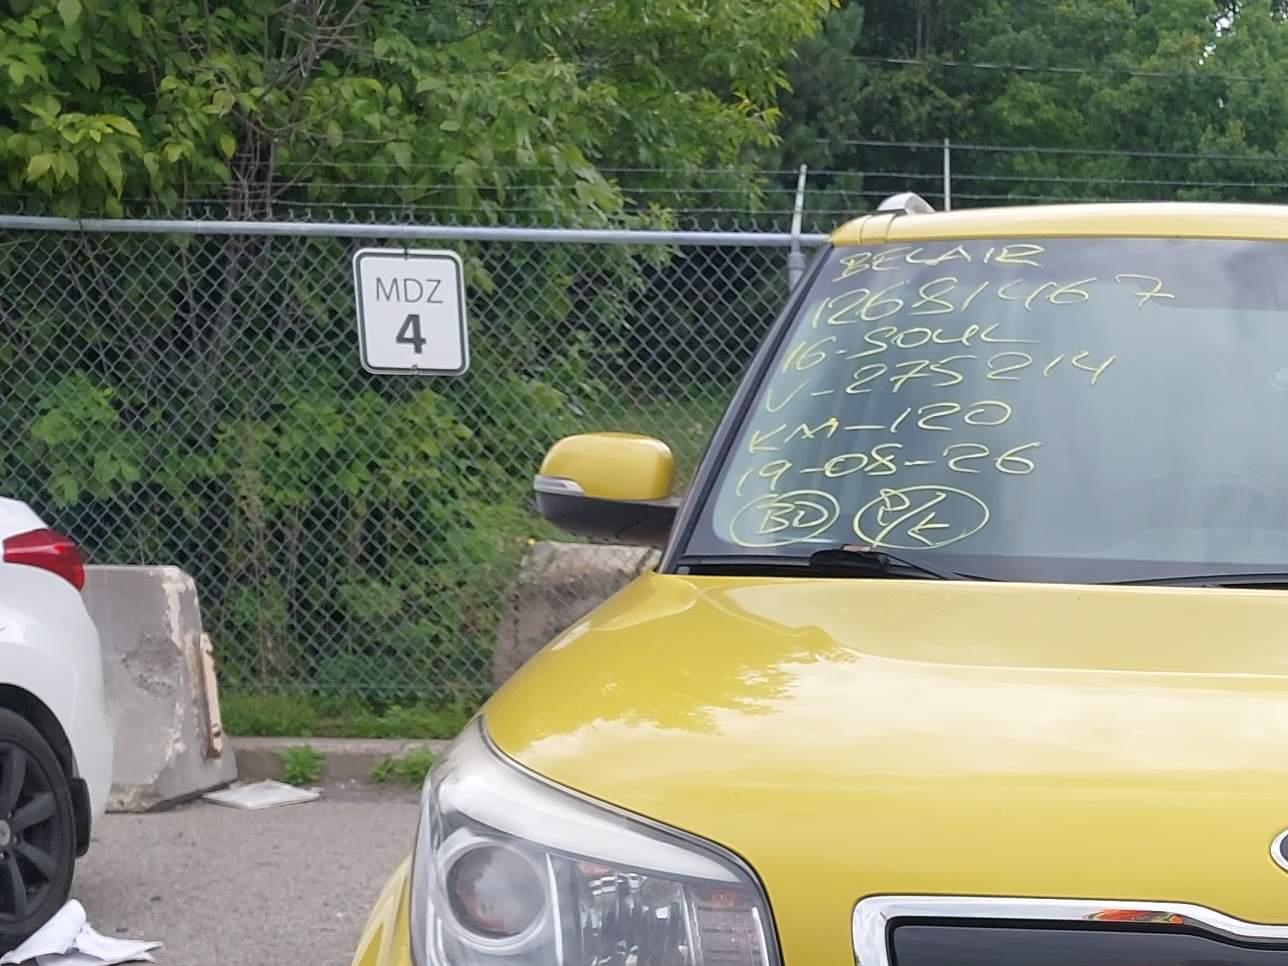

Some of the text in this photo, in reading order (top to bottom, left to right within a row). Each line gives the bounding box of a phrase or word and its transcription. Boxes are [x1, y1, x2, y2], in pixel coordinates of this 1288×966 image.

[832, 244, 1046, 281] BELAIR
[375, 277, 443, 304] MDZ
[396, 313, 427, 354] 4
[750, 400, 1012, 452] KM-120
[736, 441, 1043, 495] 19-08-26
